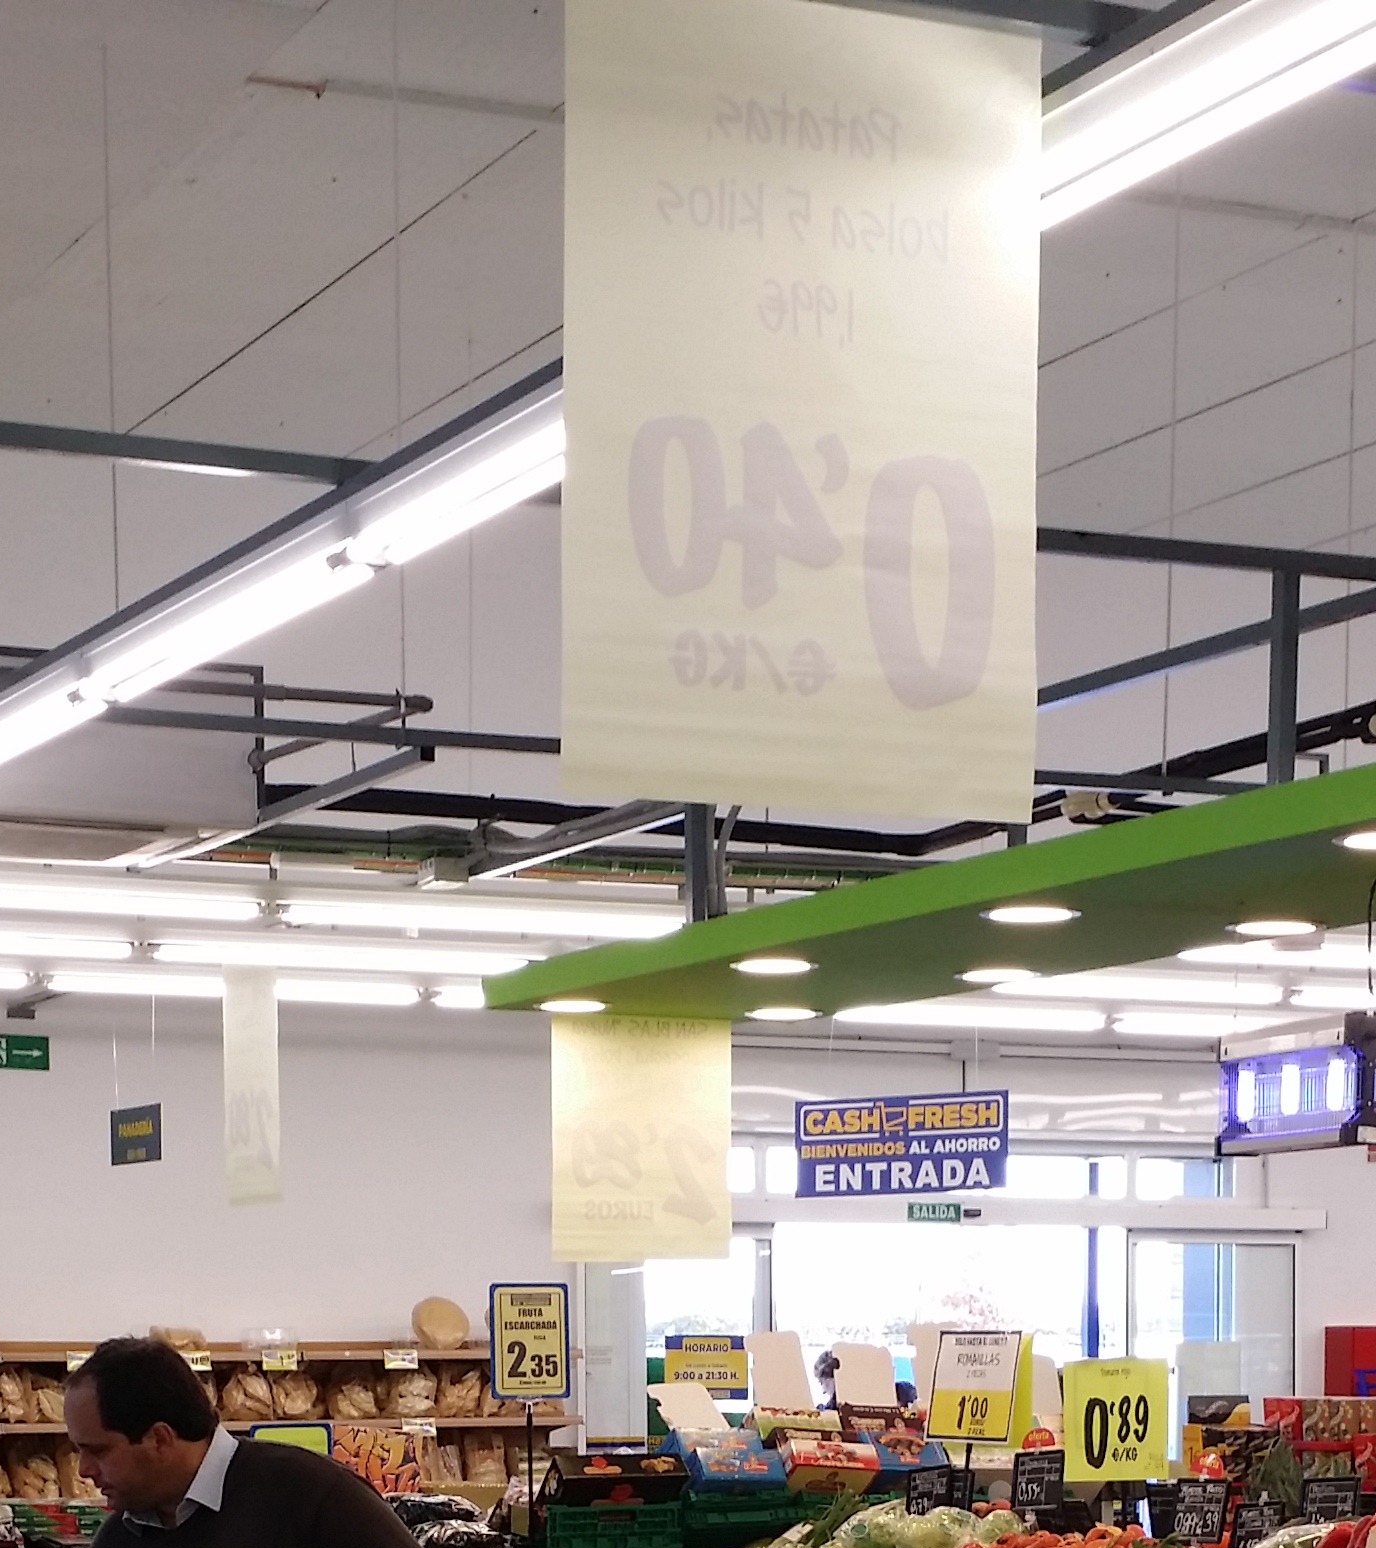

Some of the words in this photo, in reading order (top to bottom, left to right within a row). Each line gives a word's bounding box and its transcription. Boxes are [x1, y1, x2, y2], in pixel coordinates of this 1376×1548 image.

[806, 1108, 879, 1134] CASH
[908, 1102, 998, 1129] FRESH
[801, 1142, 905, 1159] BIENVENIDOS
[909, 1140, 930, 1154] AL
[933, 1136, 1001, 1153] AHORRO
[815, 1158, 991, 1192] ENTRADA
[912, 1205, 957, 1219] SALIDA
[518, 1308, 543, 1318] FRUTA
[504, 1321, 557, 1331] ESCARCHADA
[685, 1343, 728, 1353] HORARIO
[674, 1371, 695, 1380] 9:00
[706, 1371, 728, 1380] 21:30
[1028, 1430, 1049, 1442] oferta
